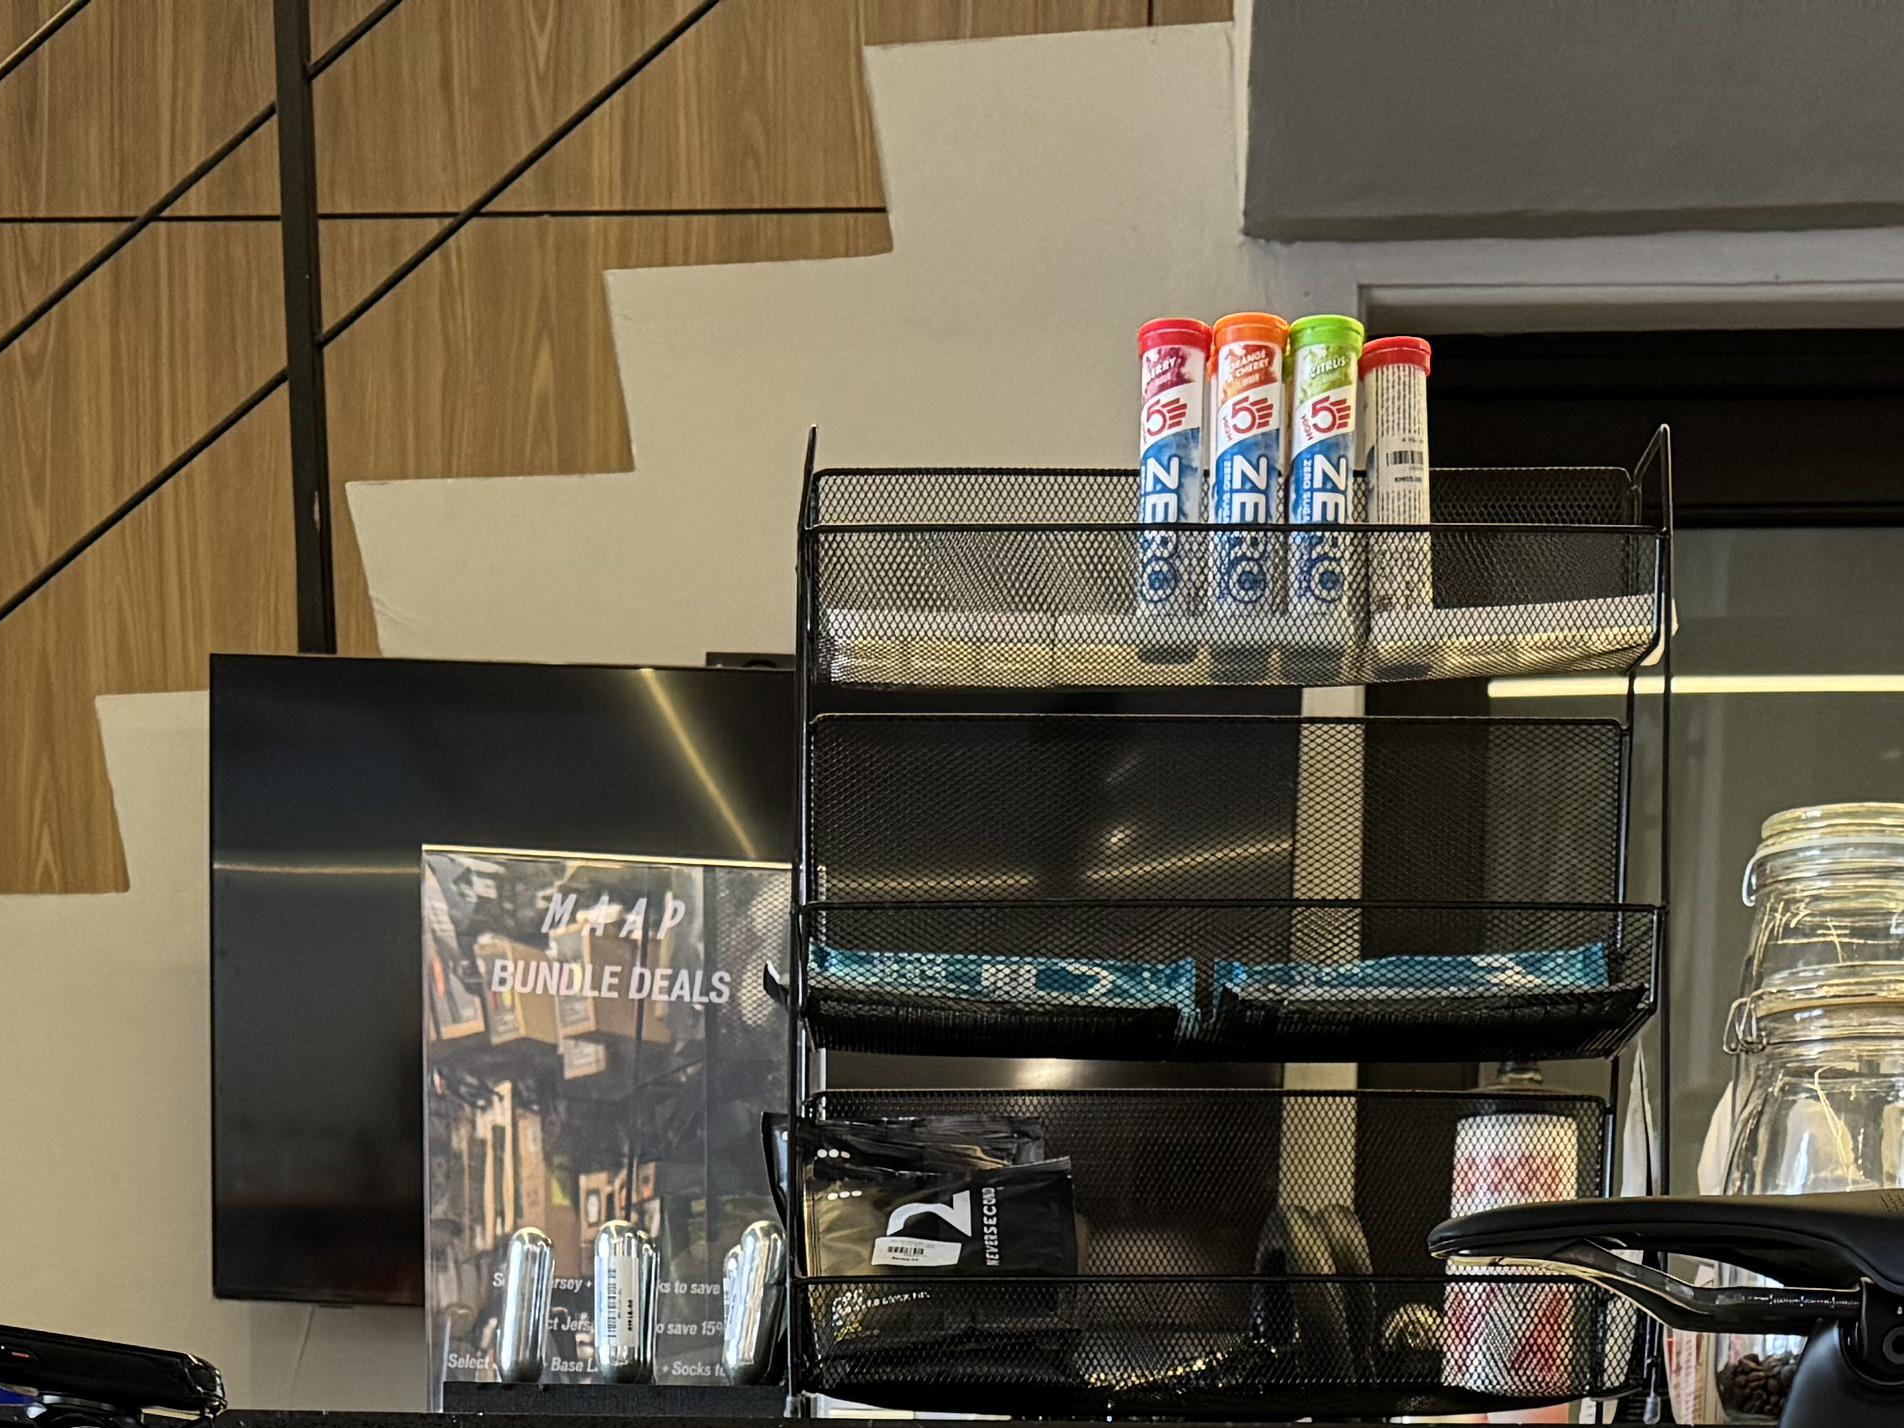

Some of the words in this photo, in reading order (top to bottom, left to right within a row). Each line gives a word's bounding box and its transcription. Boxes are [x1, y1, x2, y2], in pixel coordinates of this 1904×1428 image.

[1309, 357, 1347, 378] CITRUS
[541, 892, 686, 940] MAAP
[491, 958, 622, 998] BUNDLE
[628, 967, 731, 1003] DEALS
[690, 1283, 721, 1295] save
[667, 1323, 697, 1335] save
[448, 1354, 489, 1370] Select
[551, 1357, 584, 1372] Base
[672, 1361, 711, 1376] Socks
